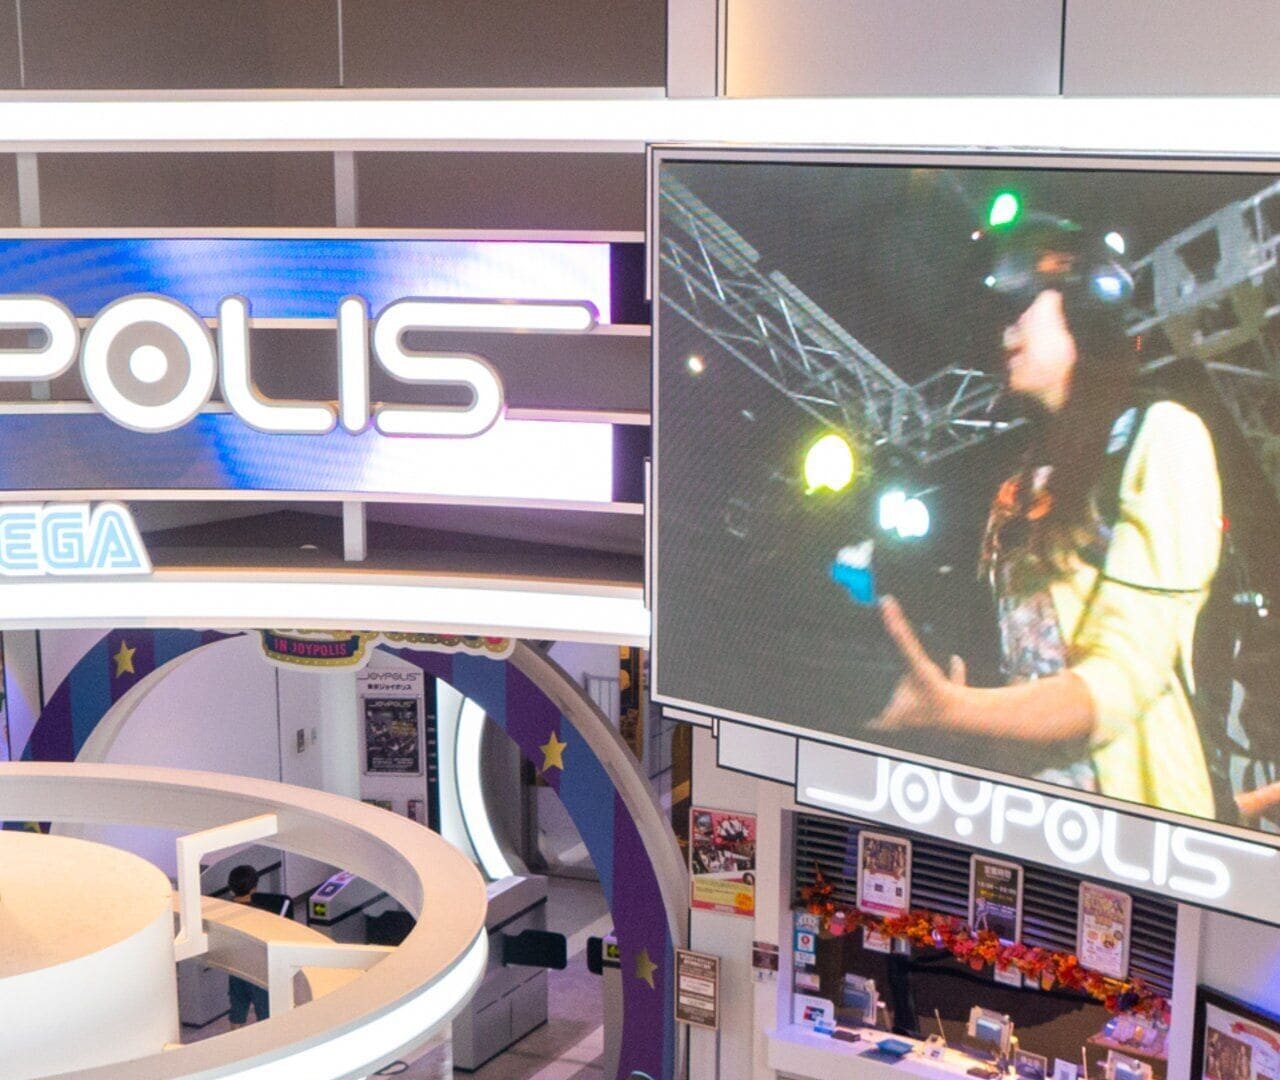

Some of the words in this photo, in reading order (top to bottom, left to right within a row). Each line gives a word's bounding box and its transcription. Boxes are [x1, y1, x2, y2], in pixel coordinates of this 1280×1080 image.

[274, 638, 288, 654] IN
[291, 641, 348, 656] JOYPOLIS
[357, 671, 421, 681] JOYPOLIS
[805, 756, 1278, 901] JOYPOLIS
